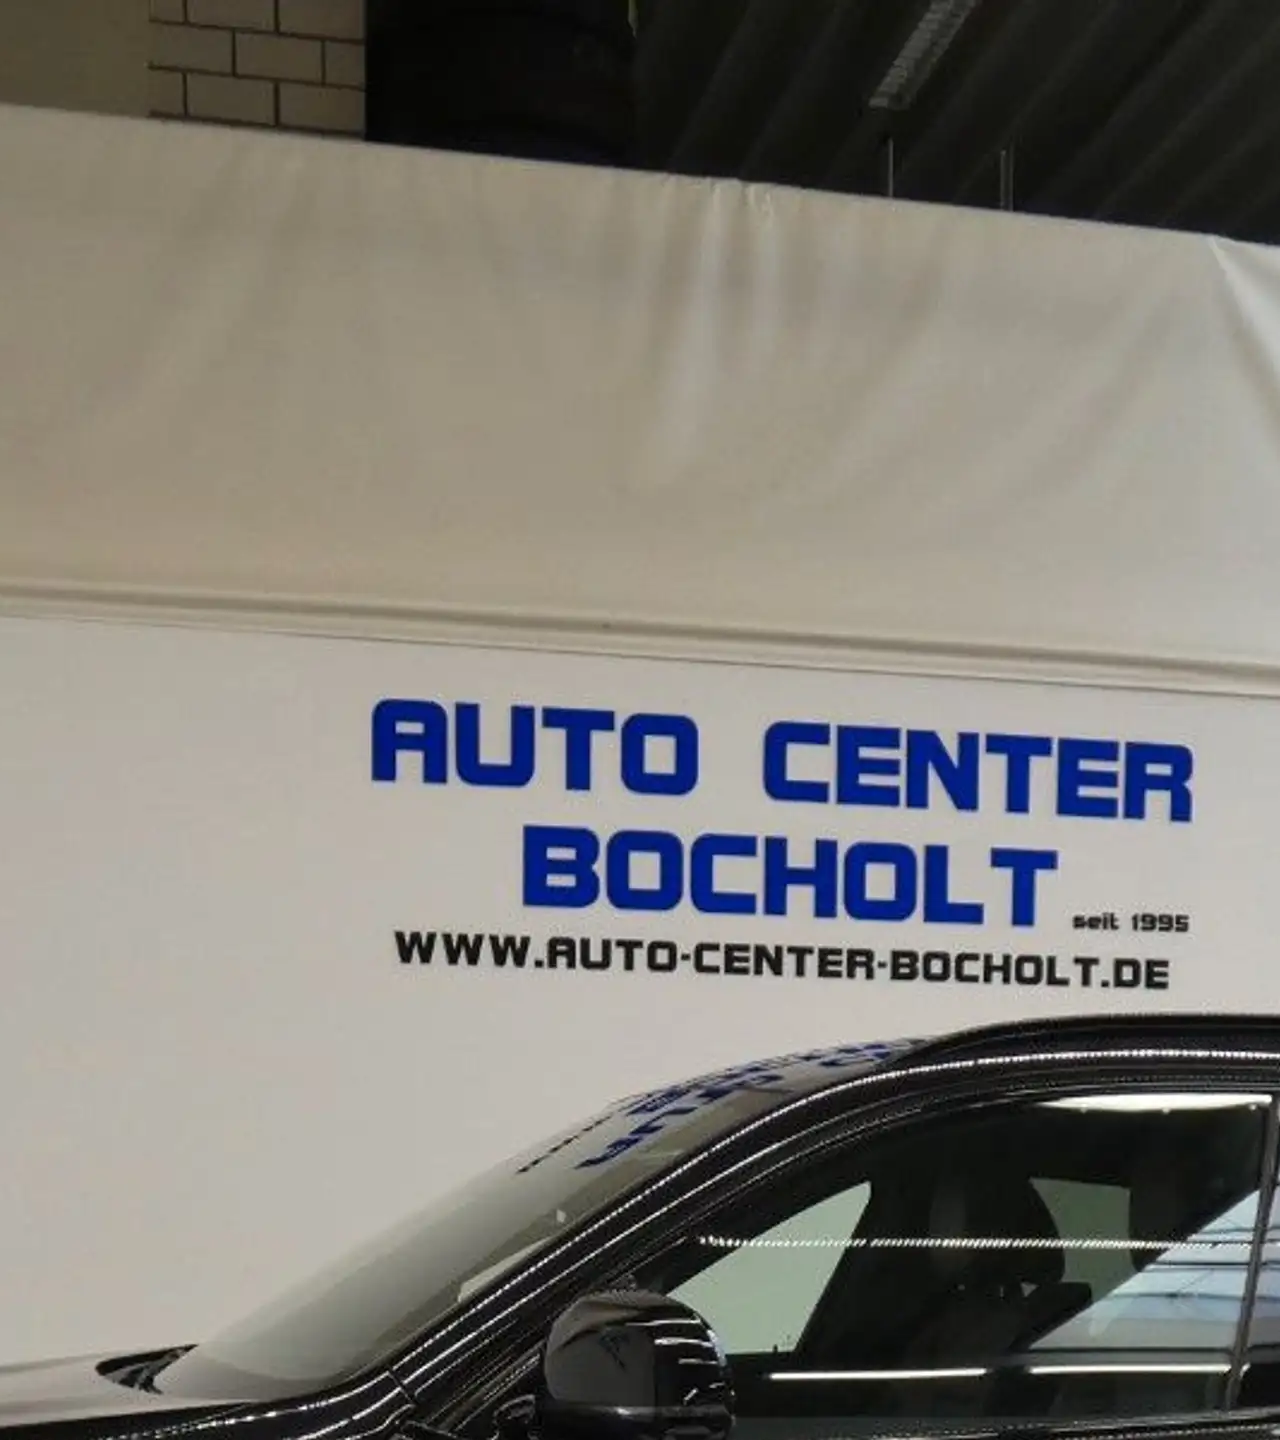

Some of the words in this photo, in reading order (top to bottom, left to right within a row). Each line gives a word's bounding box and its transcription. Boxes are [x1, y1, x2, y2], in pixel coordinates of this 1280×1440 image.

[372, 699, 700, 797] AUTO
[763, 721, 1194, 823] CENTER
[523, 826, 1059, 929] BOCHOLT
[1072, 912, 1119, 931] seit
[1131, 913, 1190, 933] 1995
[395, 930, 1170, 990] WWW.AUTO-CENTER-BOCHOLT.DE
